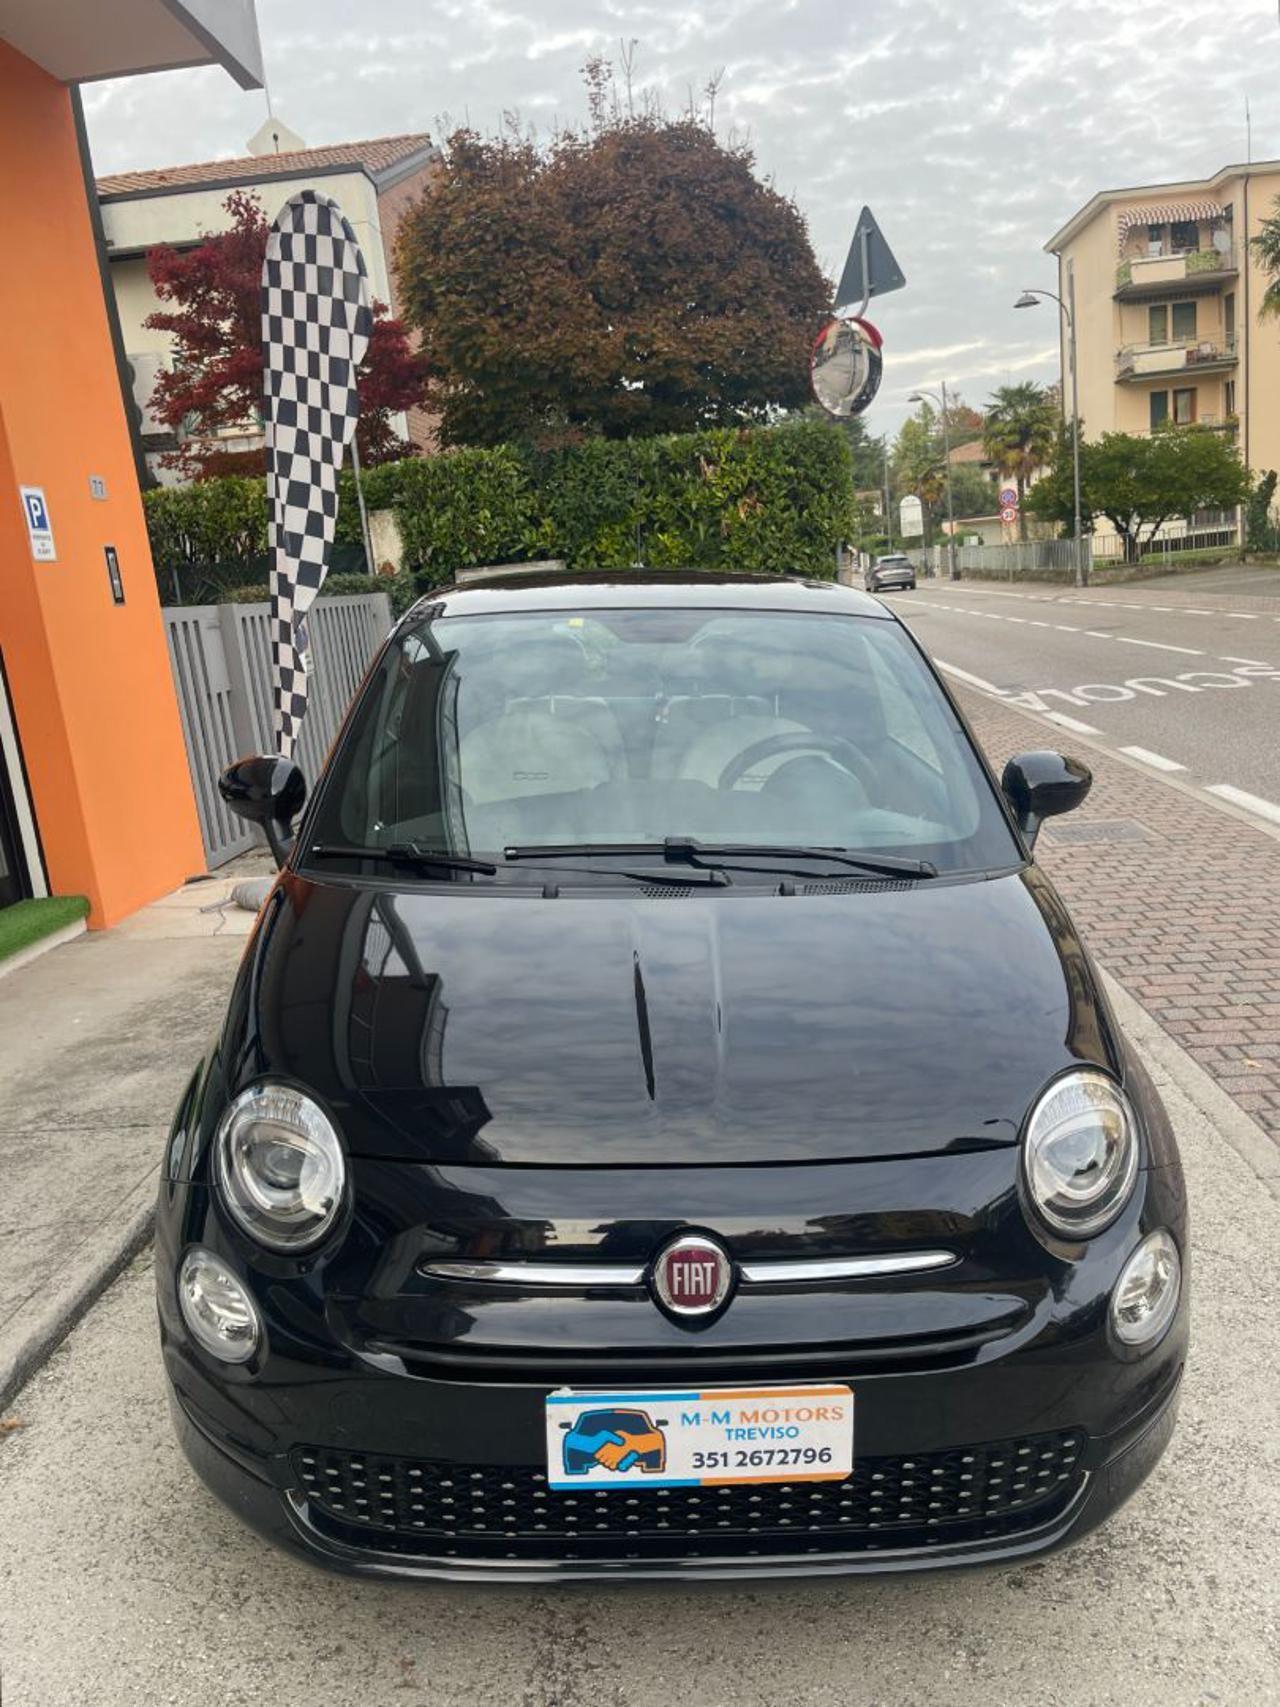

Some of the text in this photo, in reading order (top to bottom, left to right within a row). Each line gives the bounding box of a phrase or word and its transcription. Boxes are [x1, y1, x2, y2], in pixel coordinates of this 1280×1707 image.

[29, 498, 42, 528] P
[672, 1262, 716, 1296] FIAT
[680, 1406, 844, 1427] M-M MOTORS
[725, 1426, 800, 1441] TREVISO
[692, 1447, 832, 1469] 351 2672796
